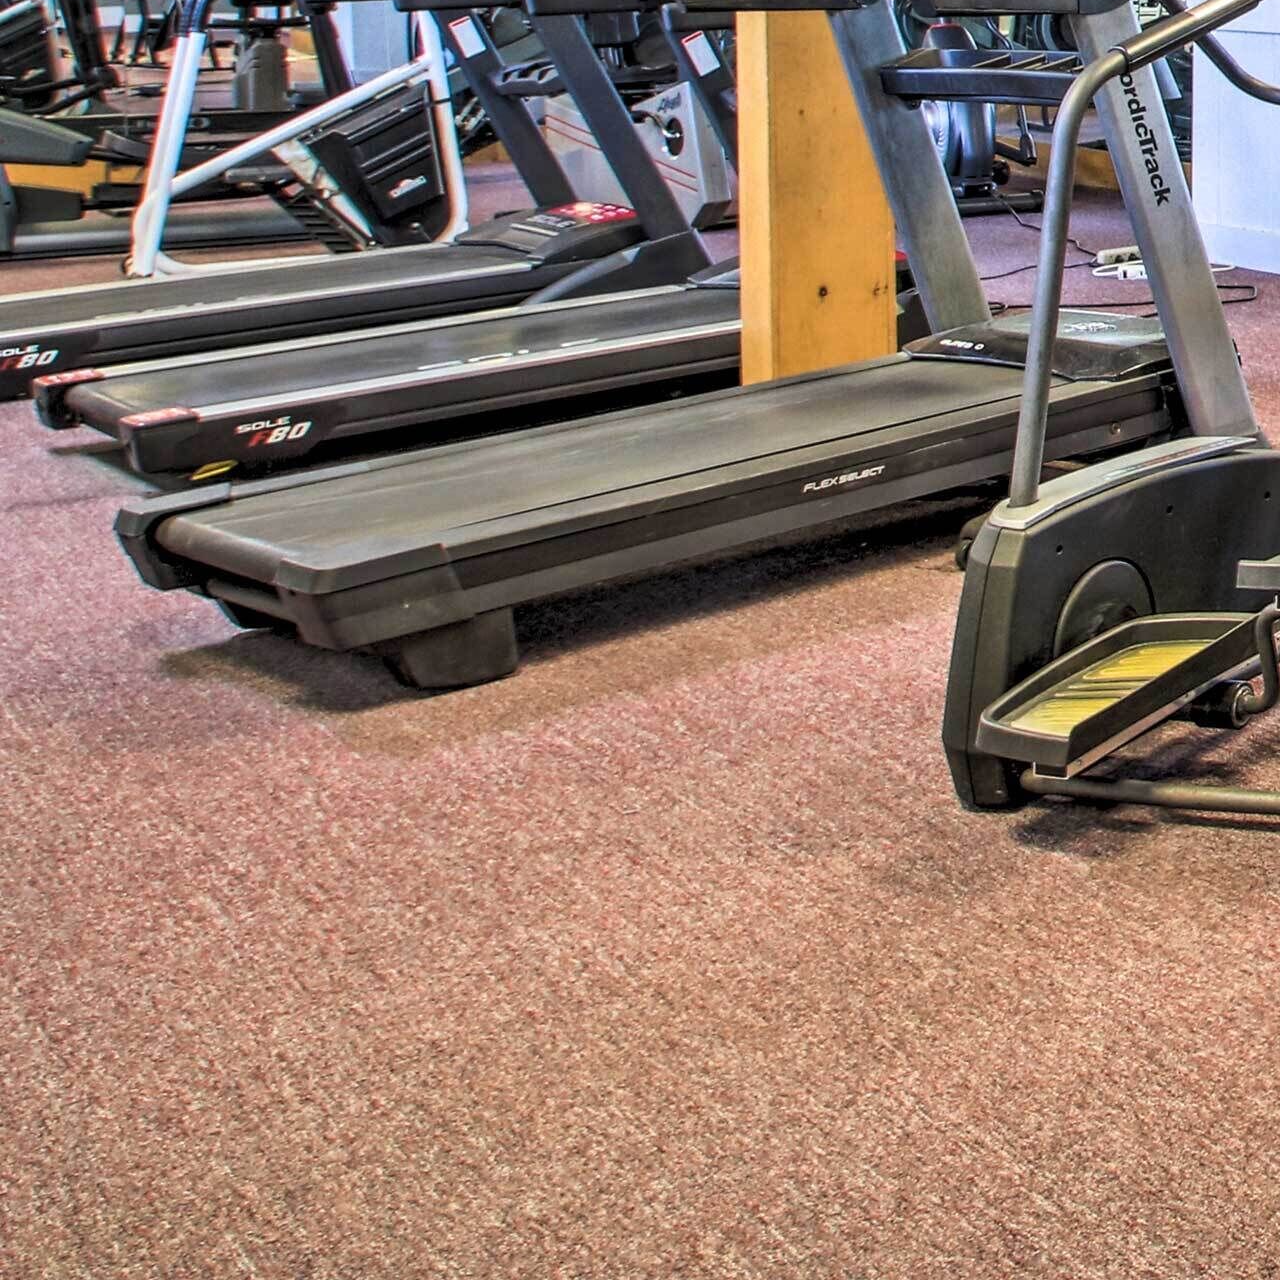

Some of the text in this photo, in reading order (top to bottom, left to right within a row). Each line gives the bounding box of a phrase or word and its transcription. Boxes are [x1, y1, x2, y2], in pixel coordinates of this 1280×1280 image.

[1120, 72, 1171, 207] ordicTrack
[235, 416, 291, 434] SOLE
[249, 421, 312, 447] F80
